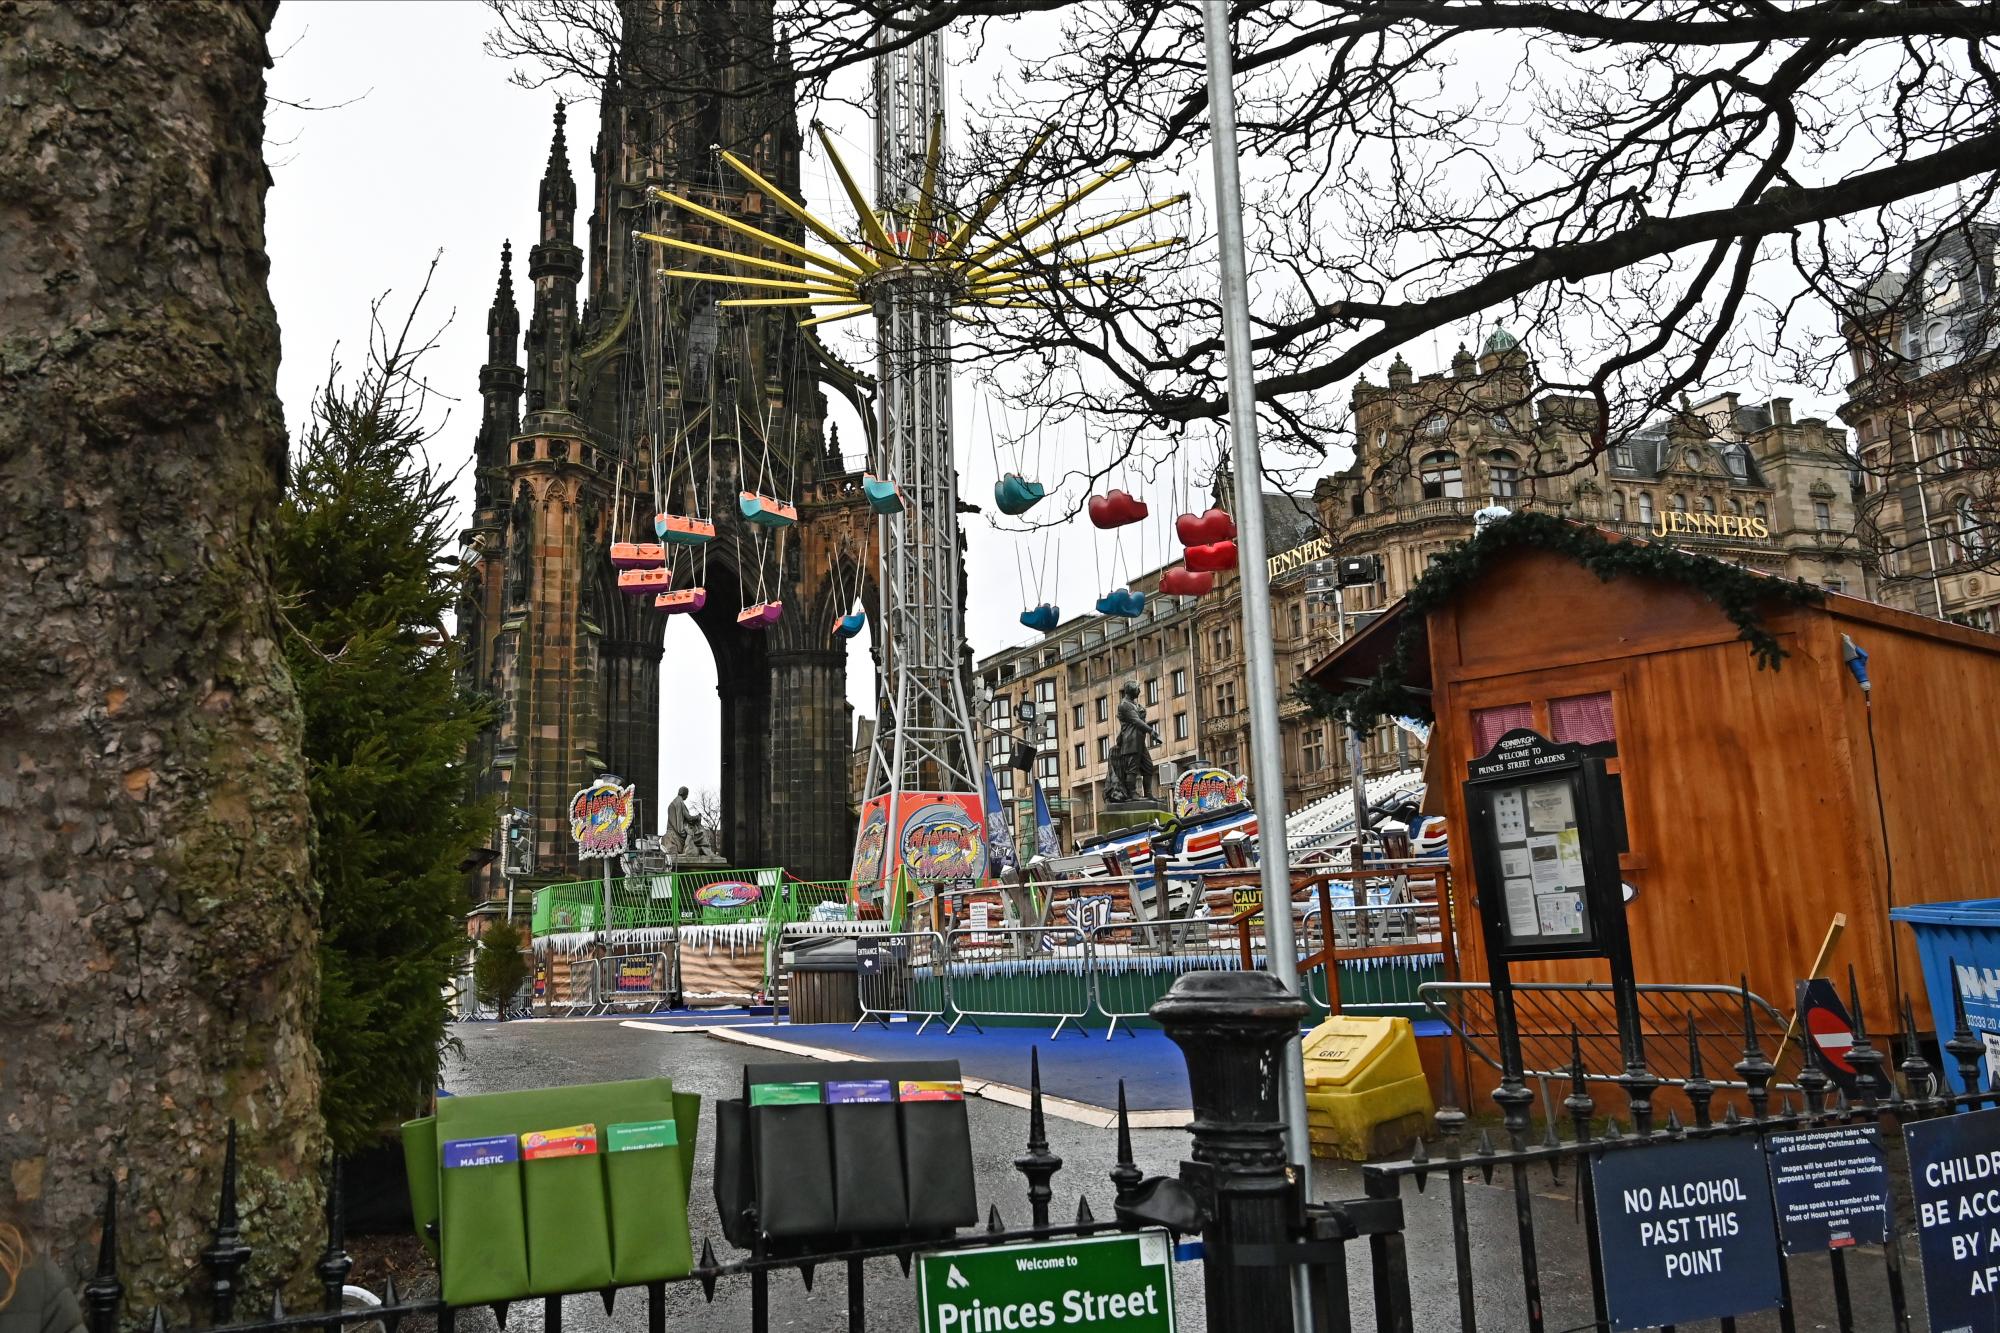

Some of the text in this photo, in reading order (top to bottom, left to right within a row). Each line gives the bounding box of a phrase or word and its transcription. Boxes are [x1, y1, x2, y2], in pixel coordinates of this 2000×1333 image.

[1652, 510, 1769, 538] JENNERS
[1266, 535, 1332, 585] JENNERS
[1498, 747, 1541, 761] WELCOME TO
[1478, 754, 1566, 774] PRINCES STREET GARDENS
[1233, 891, 1263, 903] CAUT
[1066, 897, 1110, 931] YETI
[891, 937, 906, 946] EXI
[857, 947, 878, 956] ENTRANCE
[1987, 1017, 1997, 1030] 20
[1319, 1050, 1345, 1058] GRIT
[1772, 1136, 1794, 1144] Filming
[1808, 1131, 1843, 1141] photography
[1845, 1128, 1859, 1136] takes
[1797, 1142, 1826, 1151] Edinburgh
[1828, 1140, 1854, 1148] Christmas
[460, 1155, 504, 1167] MAJESTIC
[1782, 1165, 1802, 1173] Images
[1804, 1162, 1814, 1170] will
[1838, 1158, 1847, 1166] for
[1848, 1156, 1876, 1165] marketing
[1778, 1176, 1804, 1184] purposes
[1812, 1171, 1826, 1180] print
[1827, 1170, 1838, 1178] and
[1839, 1168, 1856, 1176] online
[1857, 1165, 1882, 1173] including
[1814, 1181, 1830, 1189] social
[1623, 1178, 1746, 1213] NO ALCOHOL
[1810, 1201, 1826, 1209] speak
[1840, 1197, 1862, 1205] member
[1786, 1214, 1802, 1222] Front
[1920, 1200, 1950, 1228] BE
[1640, 1212, 1739, 1247] PAST THIS
[1828, 1219, 1849, 1227] queries
[1951, 1232, 1980, 1260] BY
[1016, 1255, 1078, 1272] Welcome to
[1665, 1248, 1722, 1278] POINT
[1970, 1265, 2000, 1296] AF
[938, 1284, 1158, 1333] Princes Street
